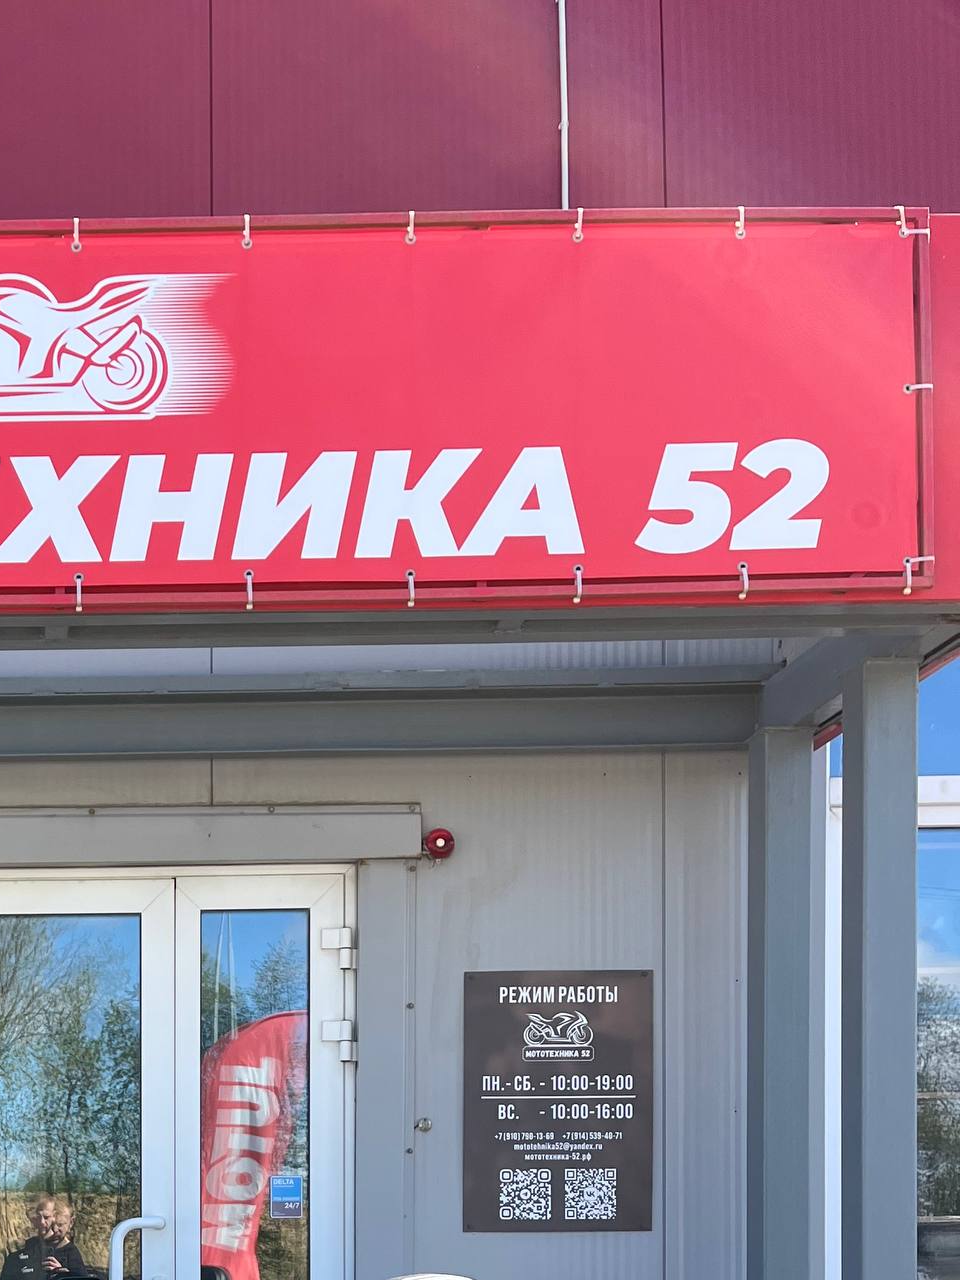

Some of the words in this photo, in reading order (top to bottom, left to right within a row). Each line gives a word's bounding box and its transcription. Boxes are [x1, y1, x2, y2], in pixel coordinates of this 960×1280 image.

[634, 438, 830, 554] 52
[499, 986, 555, 1004] РЕЖИМ
[558, 986, 618, 1003] РАБОТЫ
[525, 1050, 579, 1058] МОТОТЕХНИКА
[581, 1049, 591, 1057] 52
[550, 1075, 634, 1091] 10:00-19:00
[498, 1104, 520, 1120] ВС.
[550, 1103, 634, 1119] 10:00-16:00
[202, 1056, 281, 1253] MOTUL
